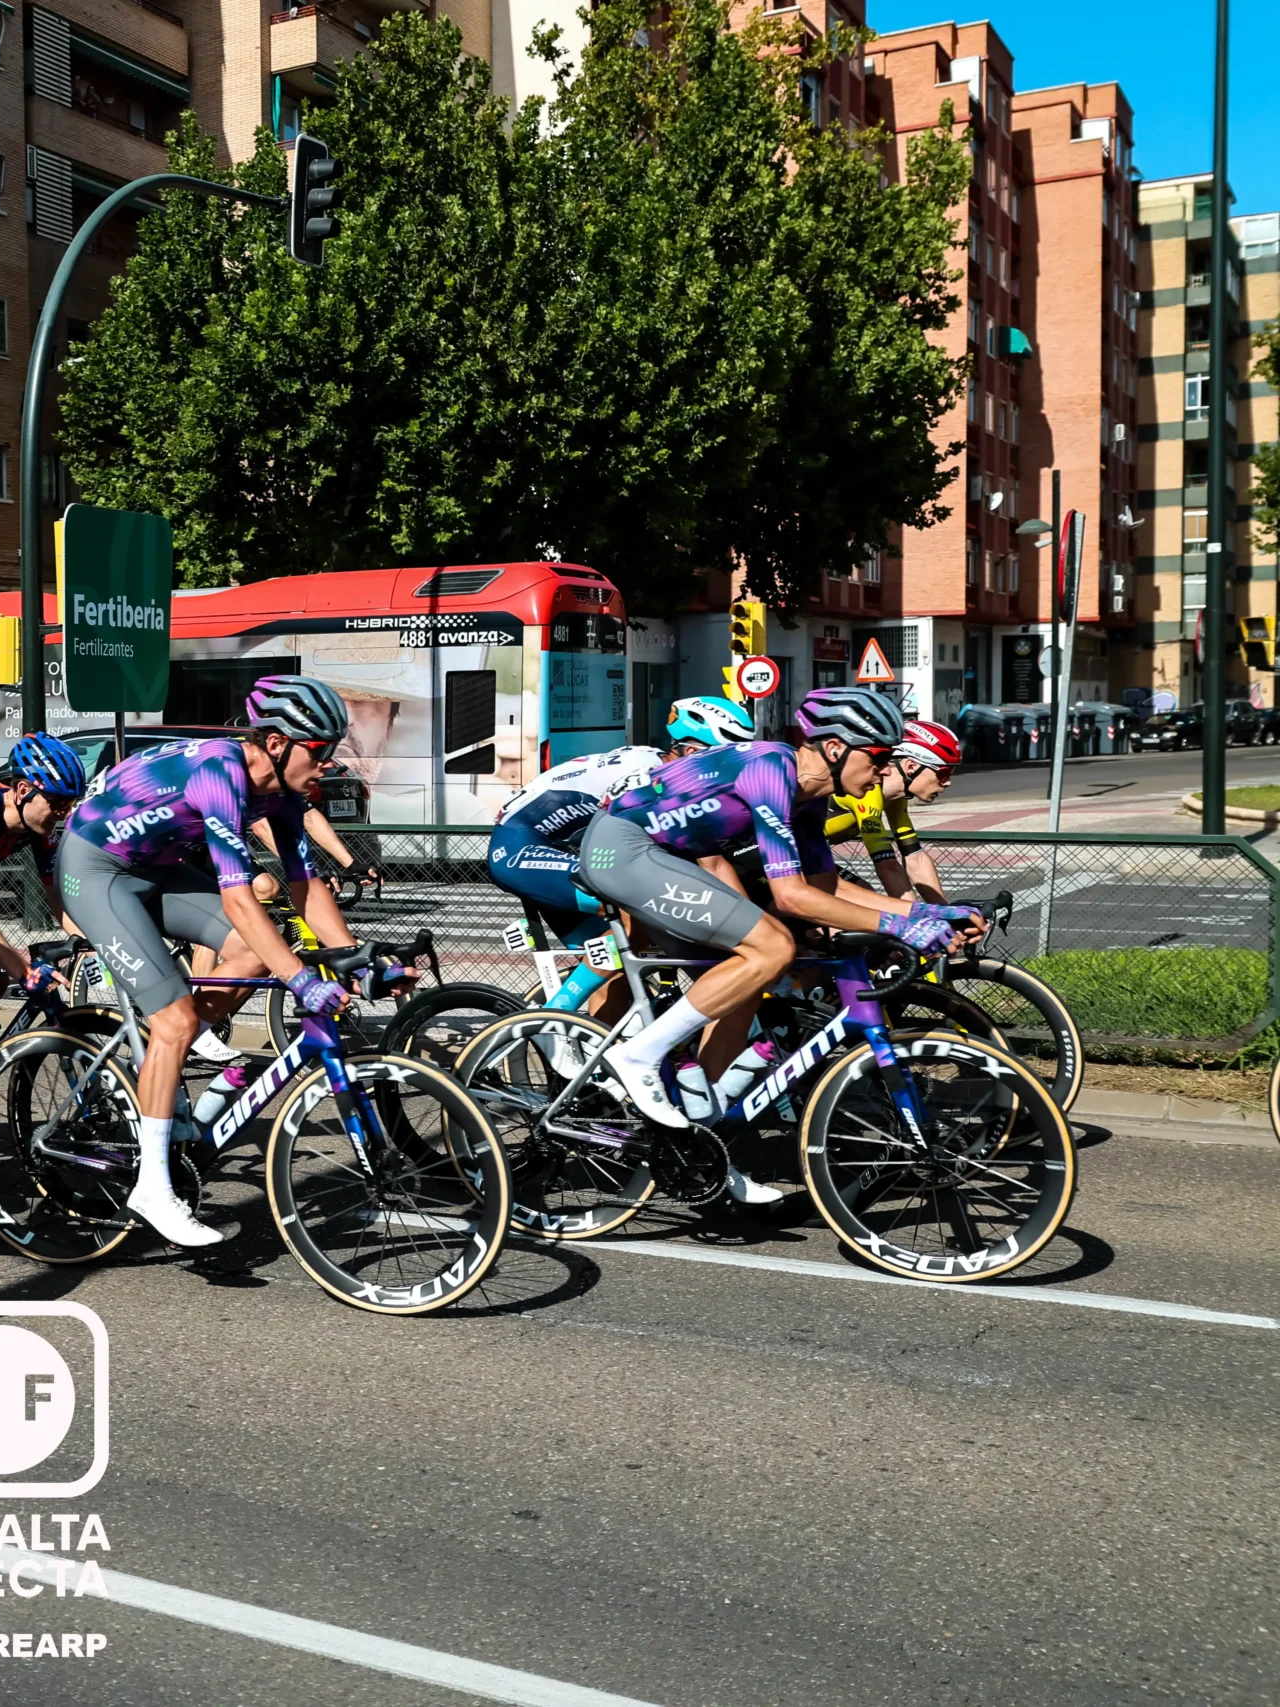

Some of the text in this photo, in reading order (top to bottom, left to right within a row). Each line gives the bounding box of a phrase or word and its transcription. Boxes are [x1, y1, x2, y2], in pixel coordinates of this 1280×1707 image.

[73, 593, 165, 631] Fertiberia
[345, 618, 410, 629] HYBRID
[73, 637, 134, 658] Fertilizantes
[400, 630, 499, 647] 4881 avanza
[554, 625, 569, 642] 4881
[551, 768, 588, 783] MERIDA
[104, 805, 175, 845] Jayco
[534, 801, 600, 836] BAHRAIN
[644, 798, 722, 835] Jayco
[754, 804, 797, 851] GIAN
[204, 816, 251, 862] GIAN
[526, 861, 563, 869] BAHRAIN
[642, 899, 713, 927] ALULA
[504, 926, 526, 950] 101
[586, 938, 610, 966] 155
[83, 958, 103, 986] 158
[742, 1005, 850, 1122] GIANT
[1060, 1030, 1074, 1079] RESERVE
[211, 1031, 306, 1149] GIANT
[901, 1107, 928, 1150] GIANT
[349, 1131, 374, 1176] GIANT
[351, 1232, 488, 1306] CADEX
[853, 1232, 1020, 1275] CADEX
